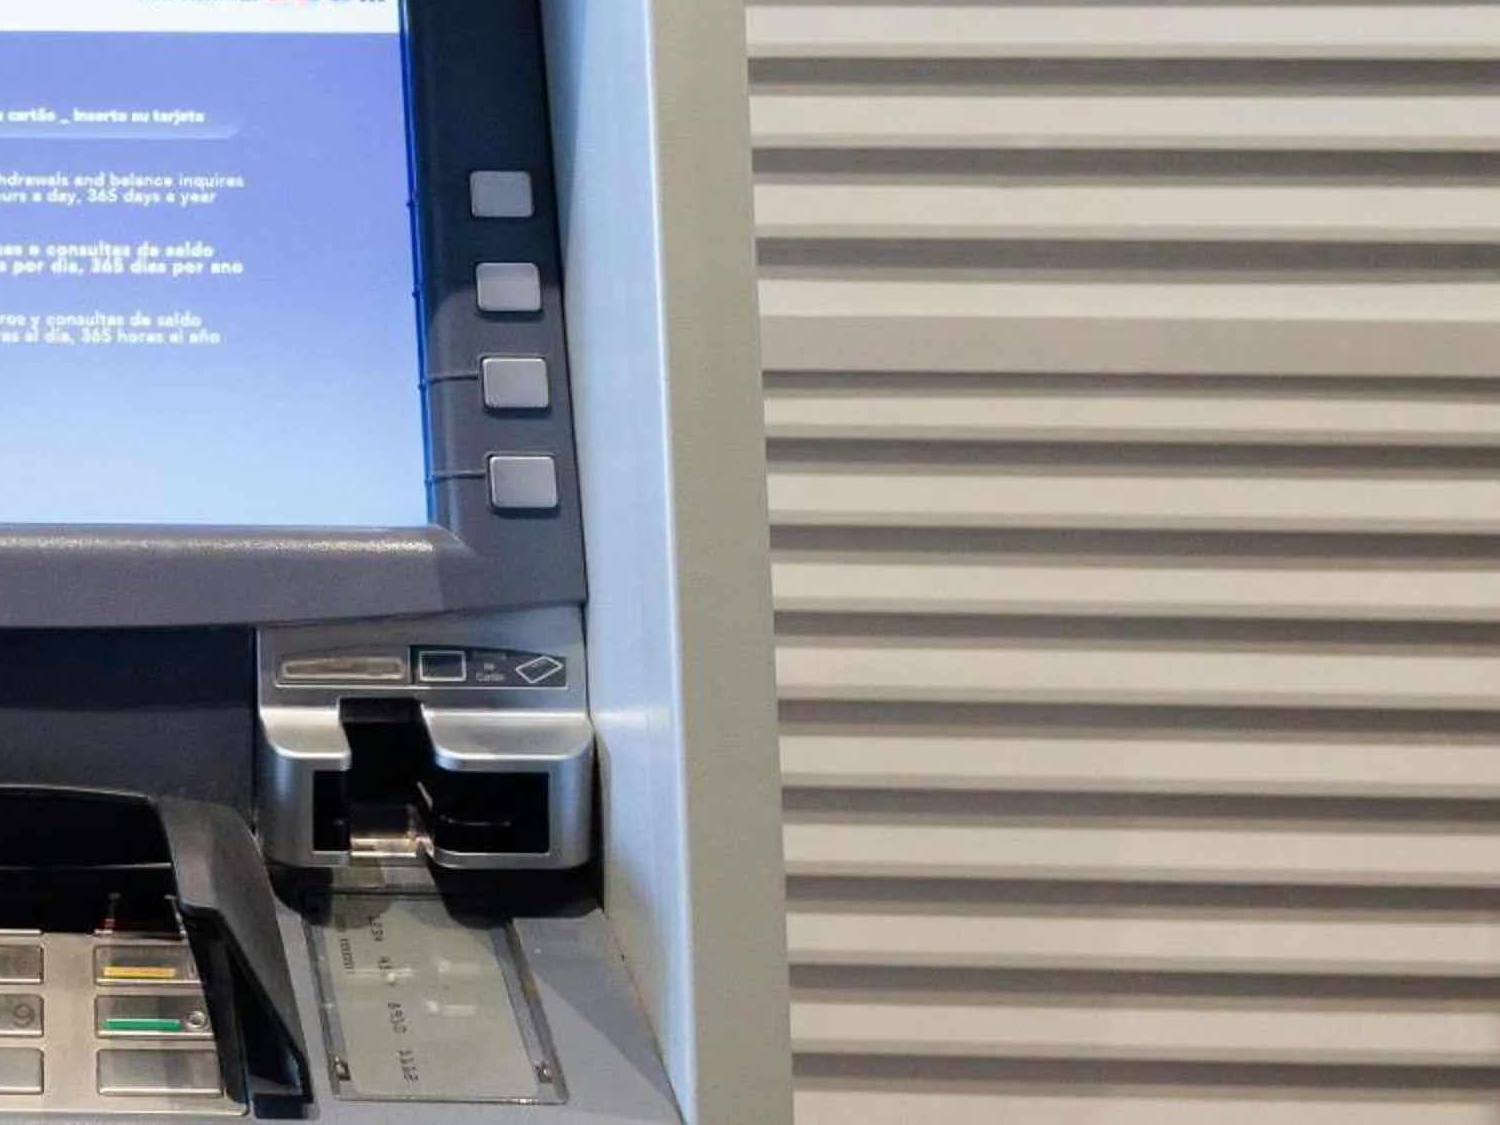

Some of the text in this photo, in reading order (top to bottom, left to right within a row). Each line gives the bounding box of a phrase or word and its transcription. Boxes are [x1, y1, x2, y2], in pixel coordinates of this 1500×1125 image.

[8, 106, 56, 123] cartão
[131, 111, 151, 124] su
[153, 108, 205, 126] tarjeta
[74, 172, 105, 188] and
[111, 173, 173, 188] balance
[31, 191, 42, 203] a
[87, 188, 117, 203] 365
[123, 188, 161, 207] days
[166, 192, 176, 203] a
[180, 191, 217, 208] year
[28, 245, 40, 257] e
[46, 241, 131, 258] consultas
[136, 241, 160, 258] de
[165, 241, 215, 258] saldo
[12, 261, 45, 277] por
[90, 257, 125, 274] 365
[130, 257, 167, 274] dias
[172, 262, 205, 278] por
[210, 262, 245, 275] ano
[28, 314, 40, 331] y
[46, 310, 124, 327] consultas
[129, 311, 152, 327] de
[156, 311, 203, 327] saldo
[81, 328, 112, 344] 365
[117, 328, 164, 345] horas
[12, 1002, 37, 1029] 9
